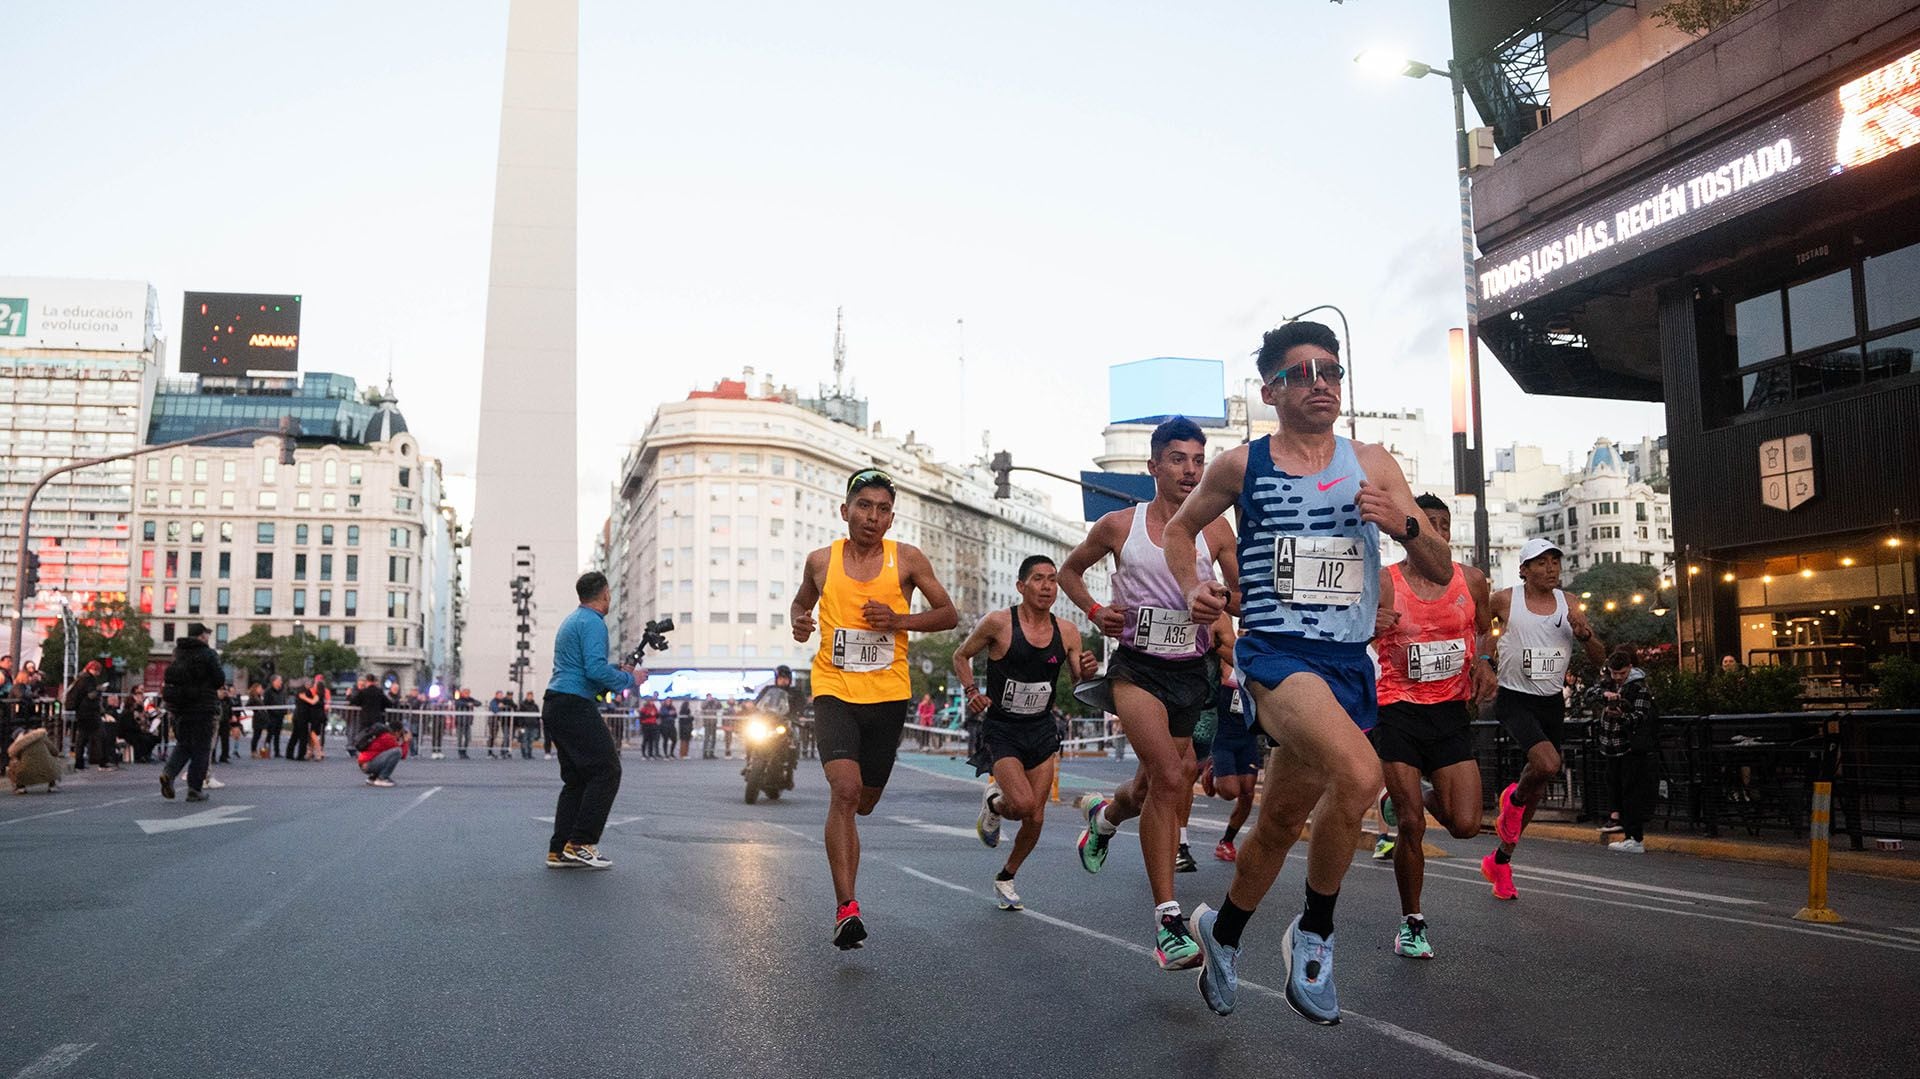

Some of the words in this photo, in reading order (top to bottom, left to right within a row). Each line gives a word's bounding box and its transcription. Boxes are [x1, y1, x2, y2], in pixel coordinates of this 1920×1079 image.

[1480, 254, 1531, 300] TODOS
[1532, 240, 1564, 280] LOS
[1565, 221, 1614, 264] DÍAS.
[1615, 184, 1687, 242] RECIÉN
[1688, 138, 1801, 210] TOSTADO.
[1796, 244, 1829, 265] TOSTADO
[42, 305, 58, 317] La
[62, 306, 133, 320] educación
[41, 319, 119, 332] evoluciona
[1279, 538, 1293, 563] A
[1317, 561, 1344, 588] A12
[1140, 609, 1150, 626] A
[835, 630, 845, 647] A
[1163, 625, 1188, 644] A35
[859, 645, 878, 662] A18
[1410, 645, 1420, 661] A
[1524, 649, 1531, 661] A
[1434, 655, 1451, 671] A16
[1541, 659, 1555, 672] A10
[1006, 682, 1014, 694] A
[1024, 694, 1039, 706] A17
